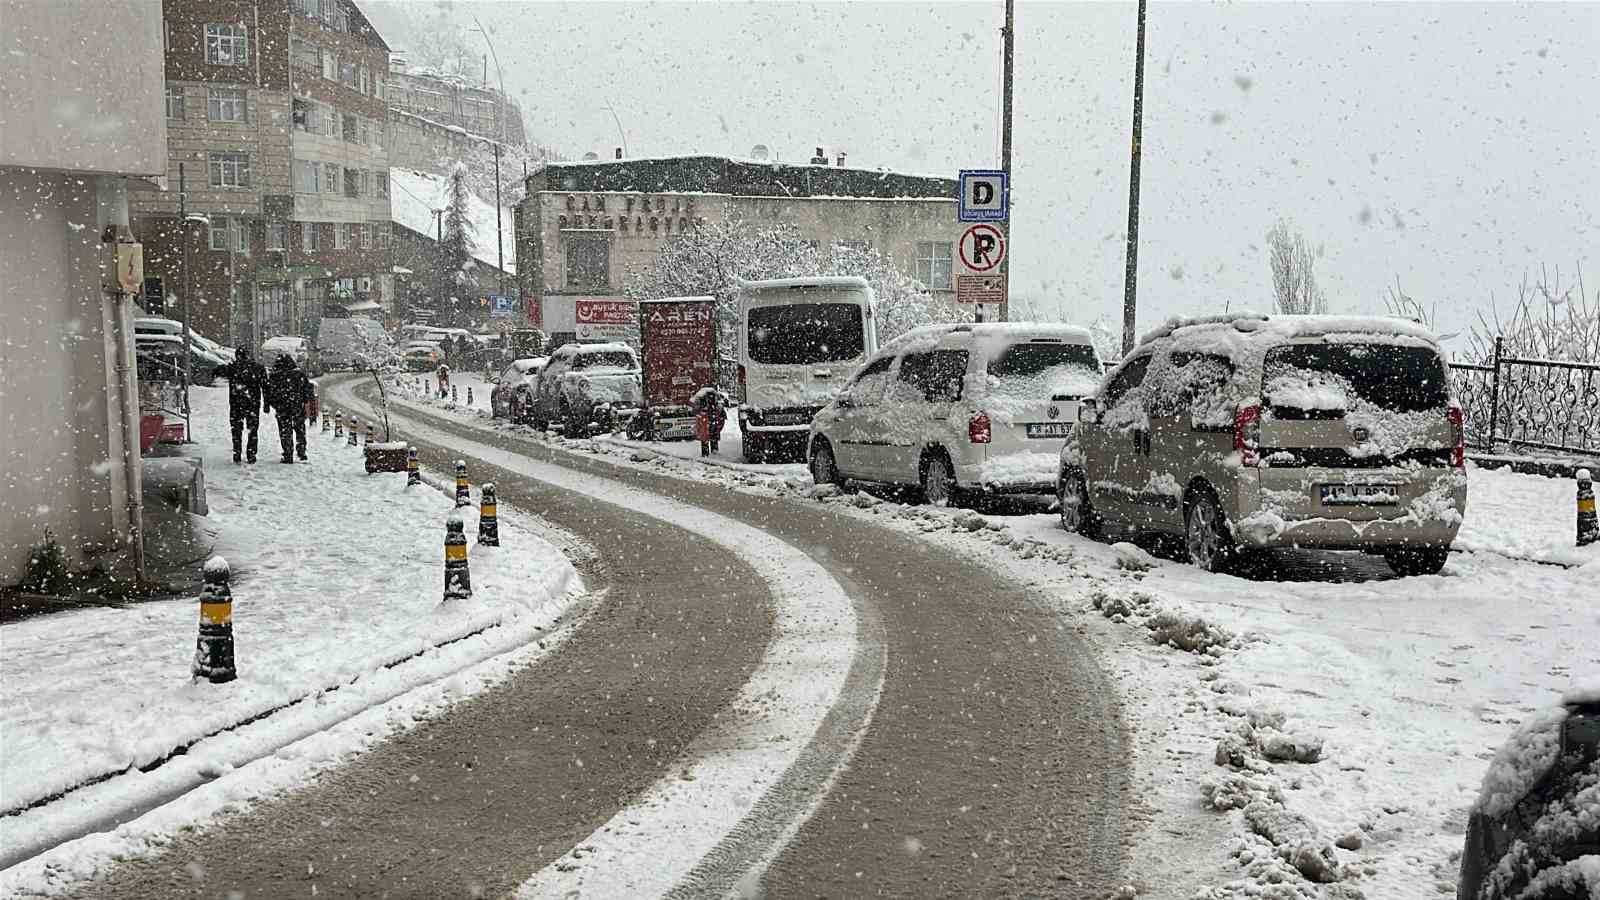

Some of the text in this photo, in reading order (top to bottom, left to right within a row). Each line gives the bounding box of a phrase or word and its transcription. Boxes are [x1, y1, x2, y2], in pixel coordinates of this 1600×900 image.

[972, 181, 994, 205] D
[973, 234, 996, 264] P
[650, 309, 711, 322] AREN
